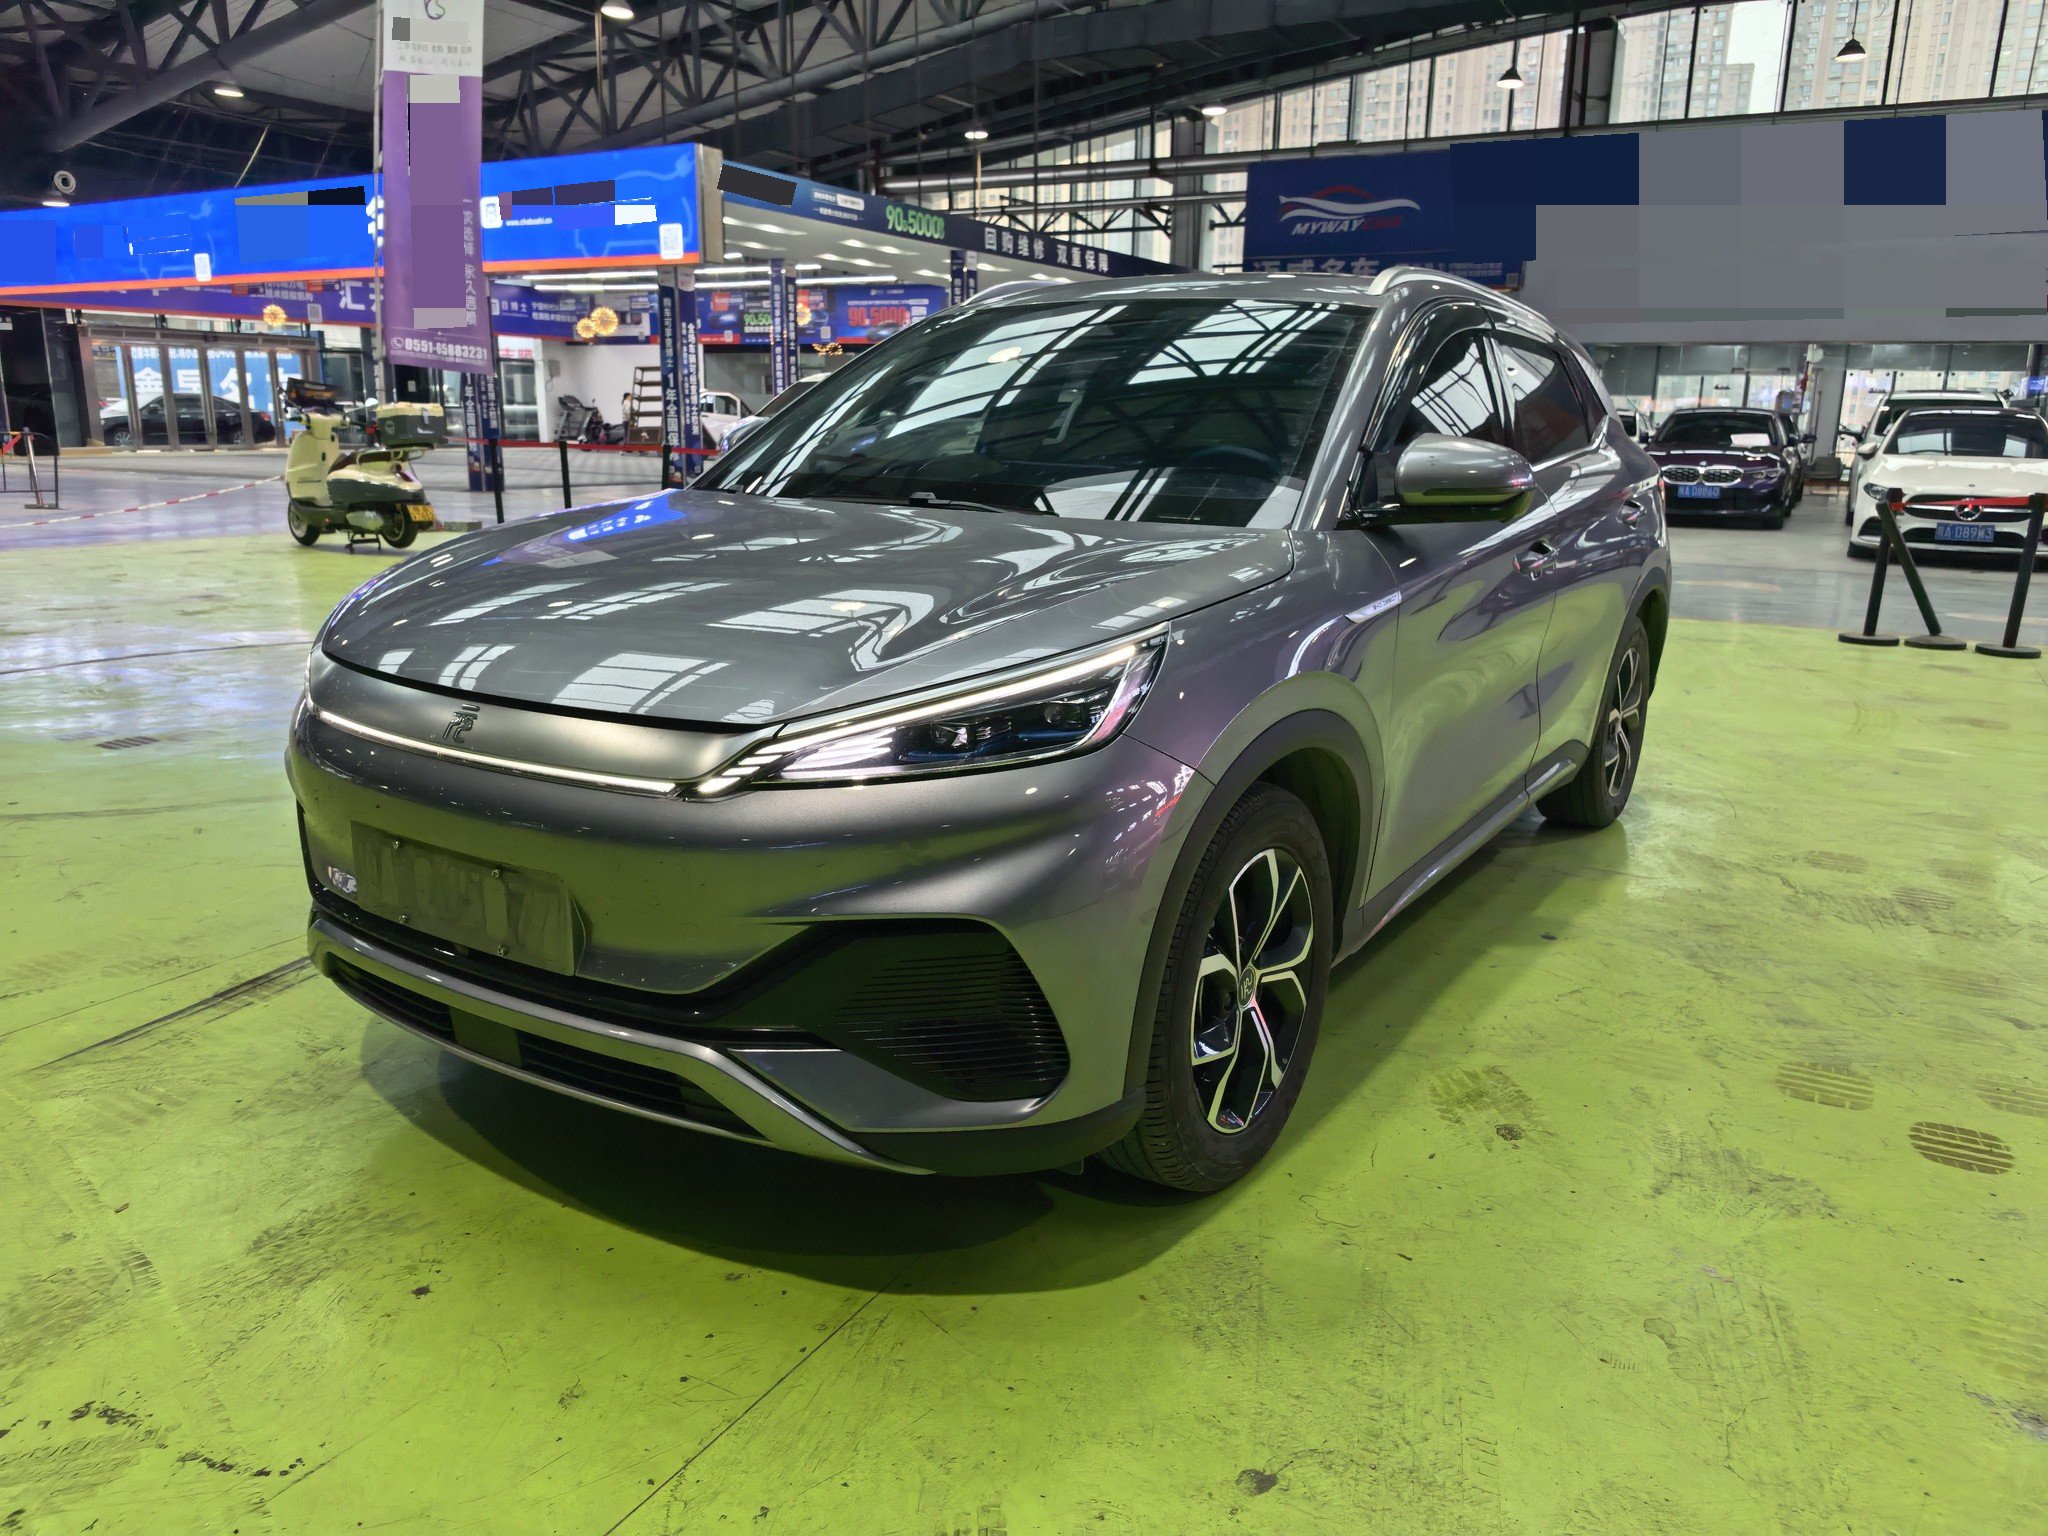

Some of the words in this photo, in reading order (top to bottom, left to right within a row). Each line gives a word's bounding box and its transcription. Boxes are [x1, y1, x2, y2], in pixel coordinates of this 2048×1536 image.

[1291, 218, 1364, 236] MYWAY
[984, 226, 1046, 260] 回购维修
[1056, 243, 1109, 273] 双重保障
